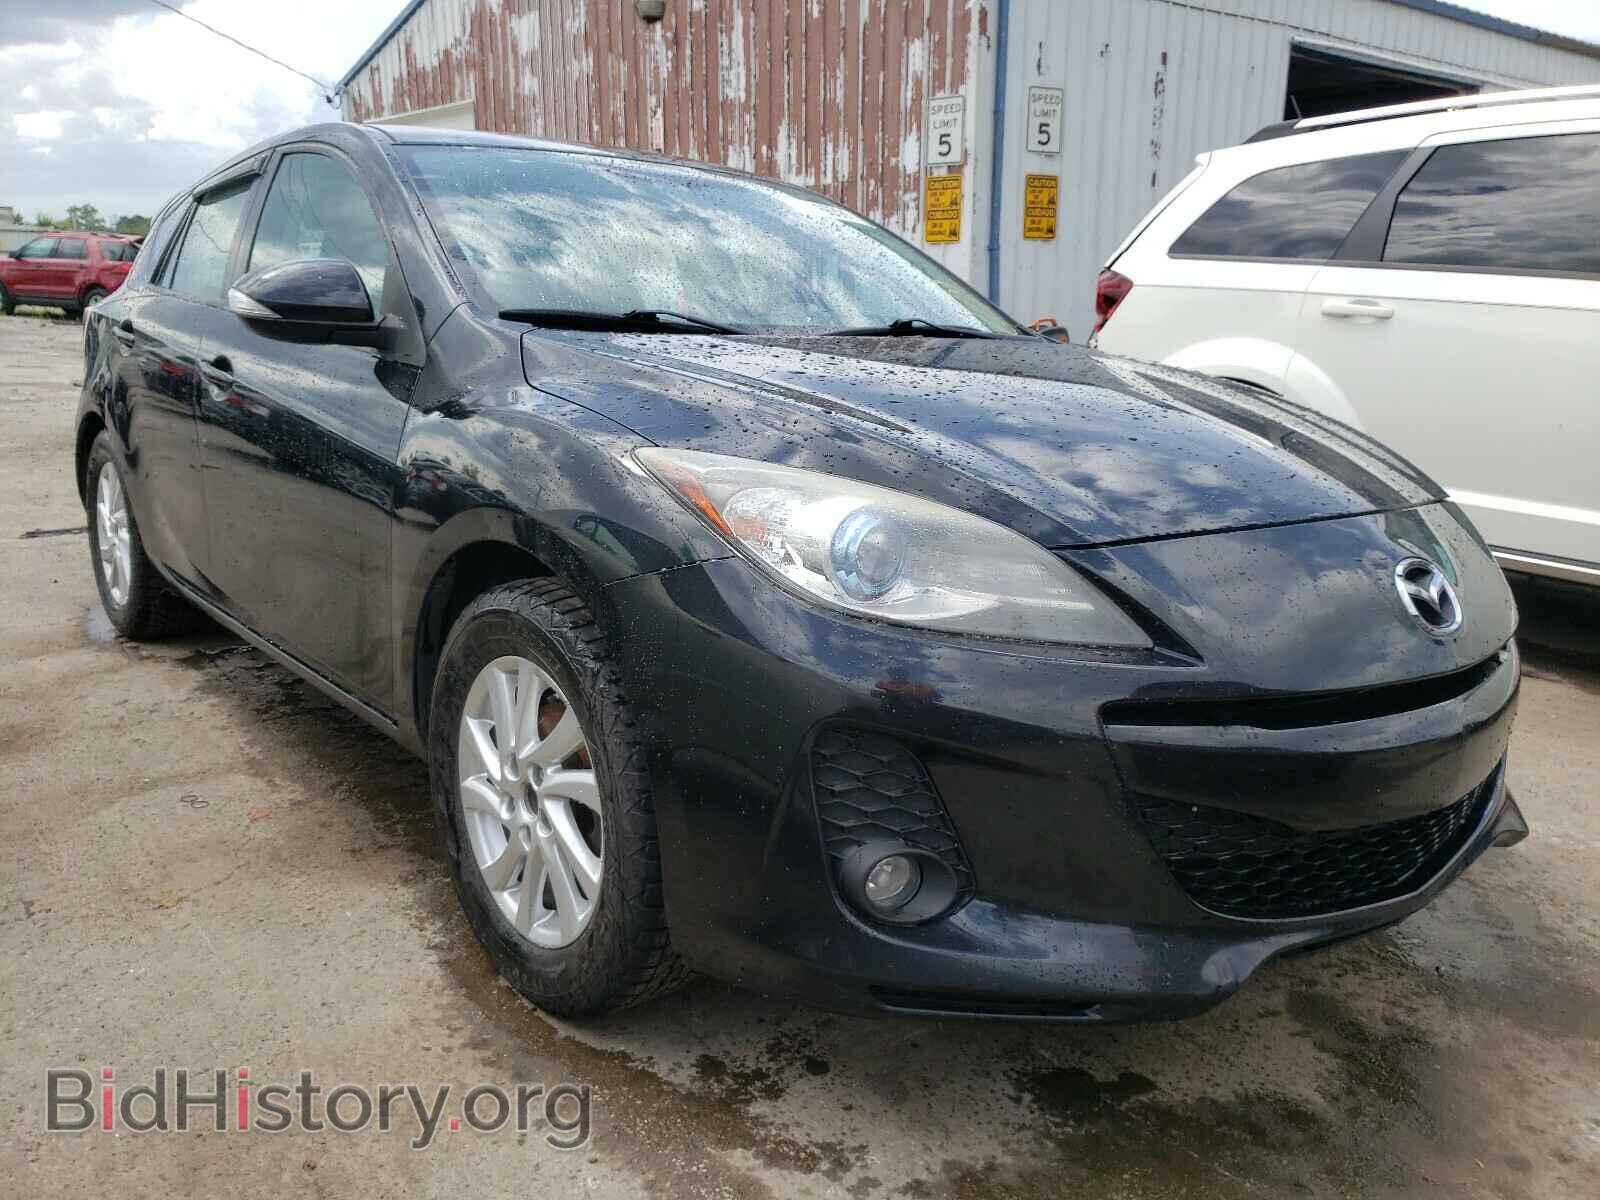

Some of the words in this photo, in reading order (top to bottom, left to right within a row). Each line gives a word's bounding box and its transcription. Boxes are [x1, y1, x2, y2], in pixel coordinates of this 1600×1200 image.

[1032, 93, 1061, 104] SPEED
[930, 104, 960, 115] SPEED
[1033, 109, 1057, 118] LIMIT
[932, 119, 957, 129] LIMIT
[1037, 123, 1051, 145] 5
[938, 133, 952, 156] 5
